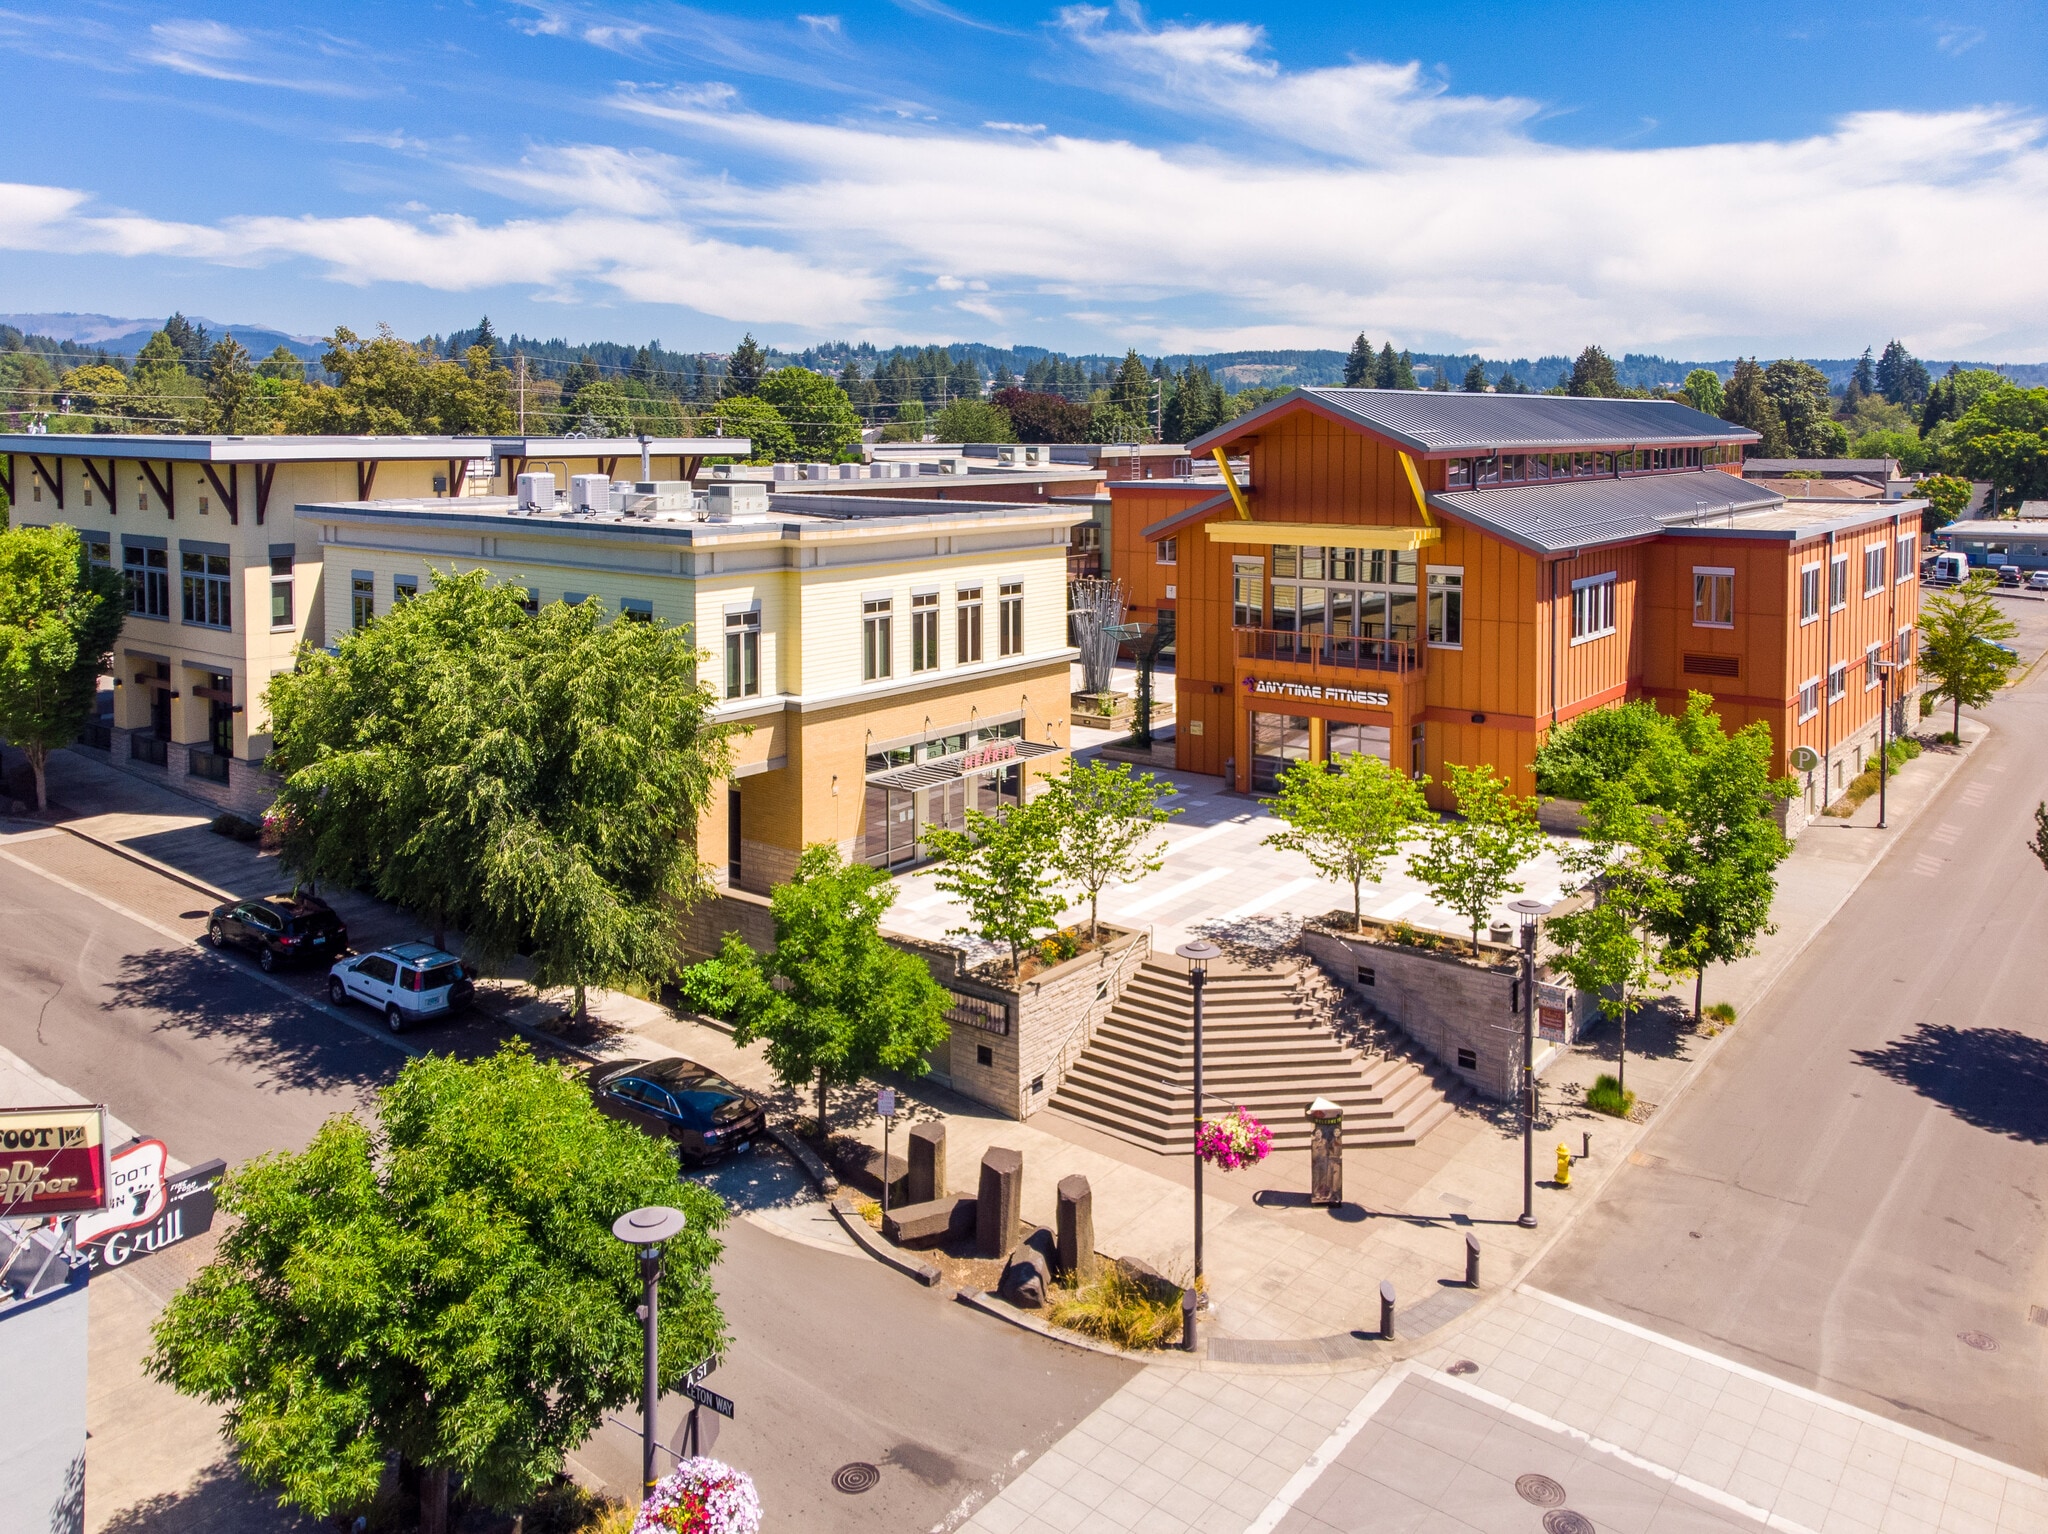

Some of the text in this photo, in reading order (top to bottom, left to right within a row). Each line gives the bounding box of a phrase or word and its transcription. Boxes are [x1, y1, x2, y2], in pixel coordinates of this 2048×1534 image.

[1256, 680, 1389, 706] ANYTIME FITNESS
[964, 745, 1016, 769] HEARTH
[1797, 750, 1811, 769] P
[0, 1128, 53, 1149] OOT
[8, 1160, 50, 1183] Dr
[111, 1164, 152, 1187] OOT
[0, 1177, 78, 1204] pper
[103, 1209, 184, 1267] Grill
[686, 1361, 708, 1388] A ST
[715, 1396, 732, 1416] WAY
